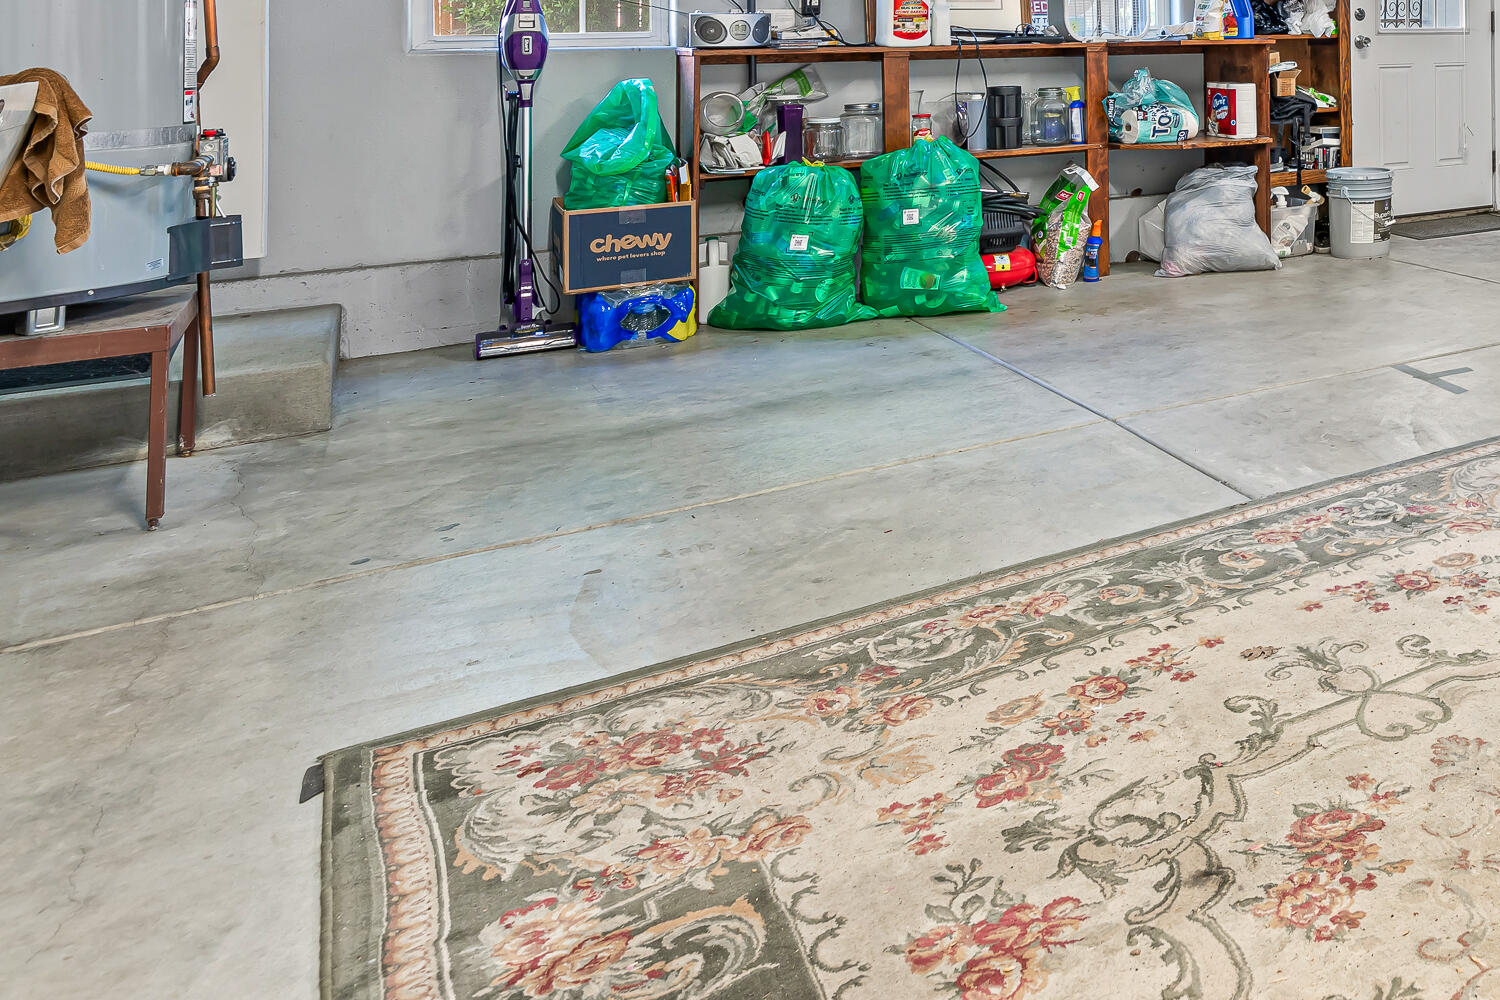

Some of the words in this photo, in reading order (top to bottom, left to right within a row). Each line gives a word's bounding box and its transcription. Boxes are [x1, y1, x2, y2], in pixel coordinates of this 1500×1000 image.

[589, 232, 673, 253] chewy
[630, 251, 649, 259] lovers
[650, 250, 665, 258] shop
